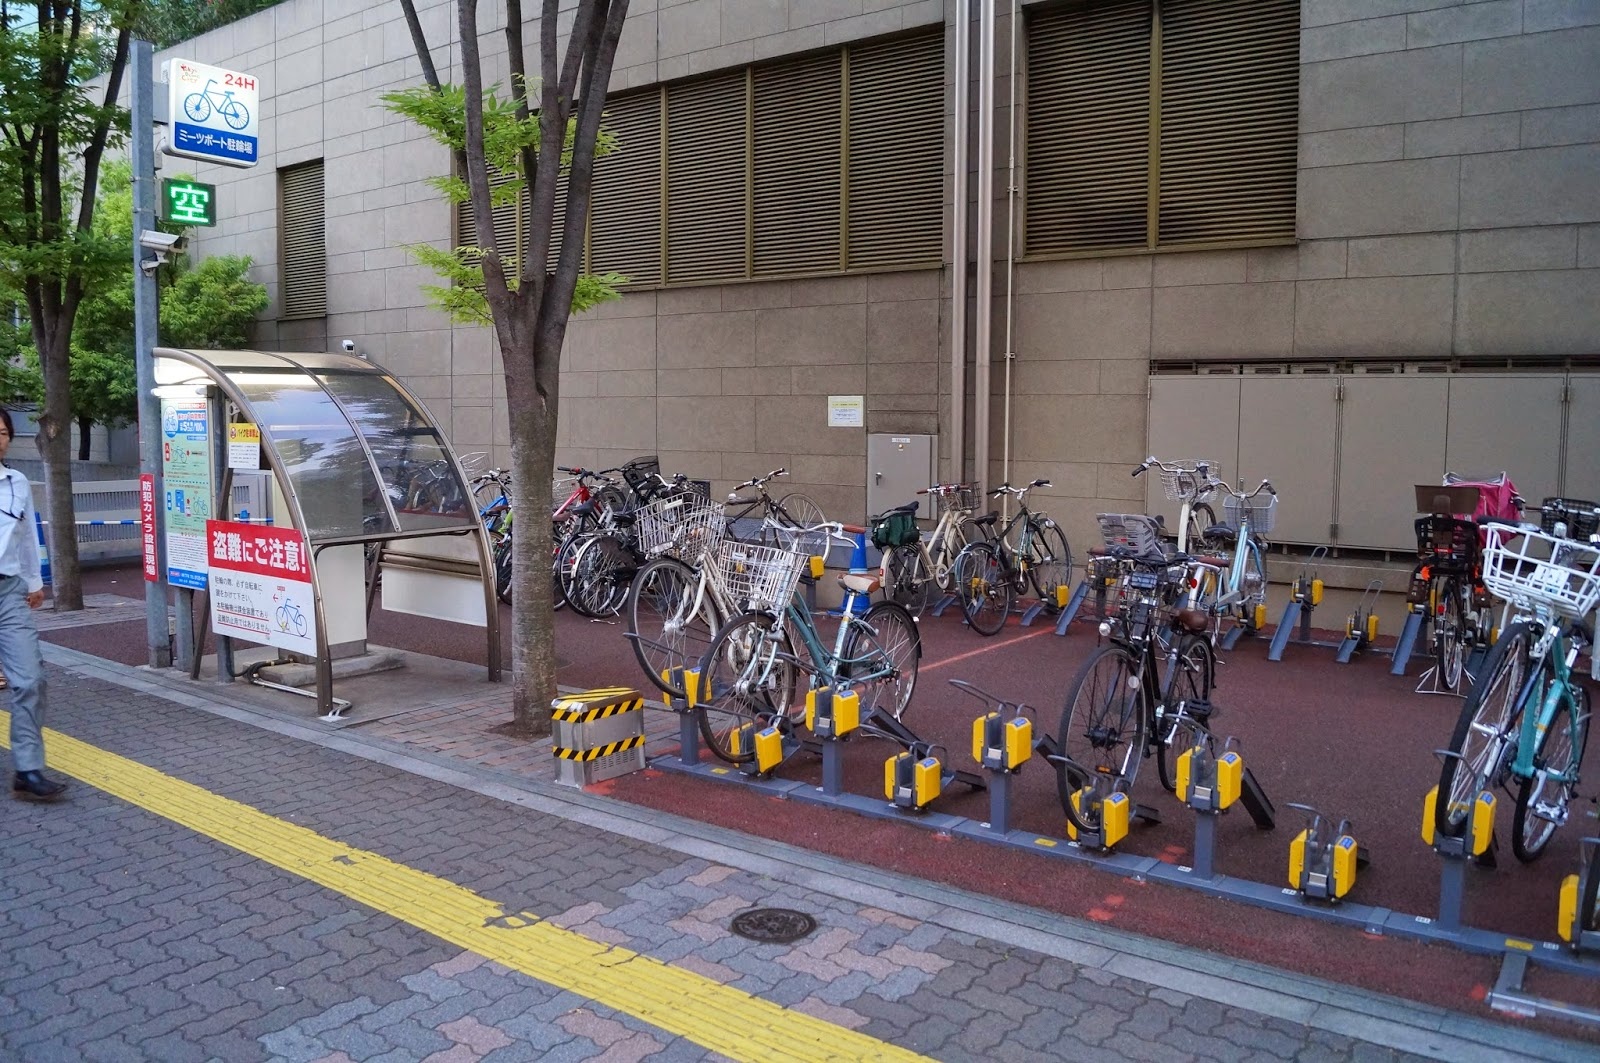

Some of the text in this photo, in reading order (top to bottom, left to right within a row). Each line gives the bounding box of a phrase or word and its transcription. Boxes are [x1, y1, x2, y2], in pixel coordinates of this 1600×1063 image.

[225, 73, 255, 91] 24H
[179, 129, 253, 155] ミーツポート駐輪場
[170, 184, 209, 223] 空
[142, 481, 156, 576] 防犯カメラ設置現場
[213, 531, 307, 575] 盗難にご注意!
